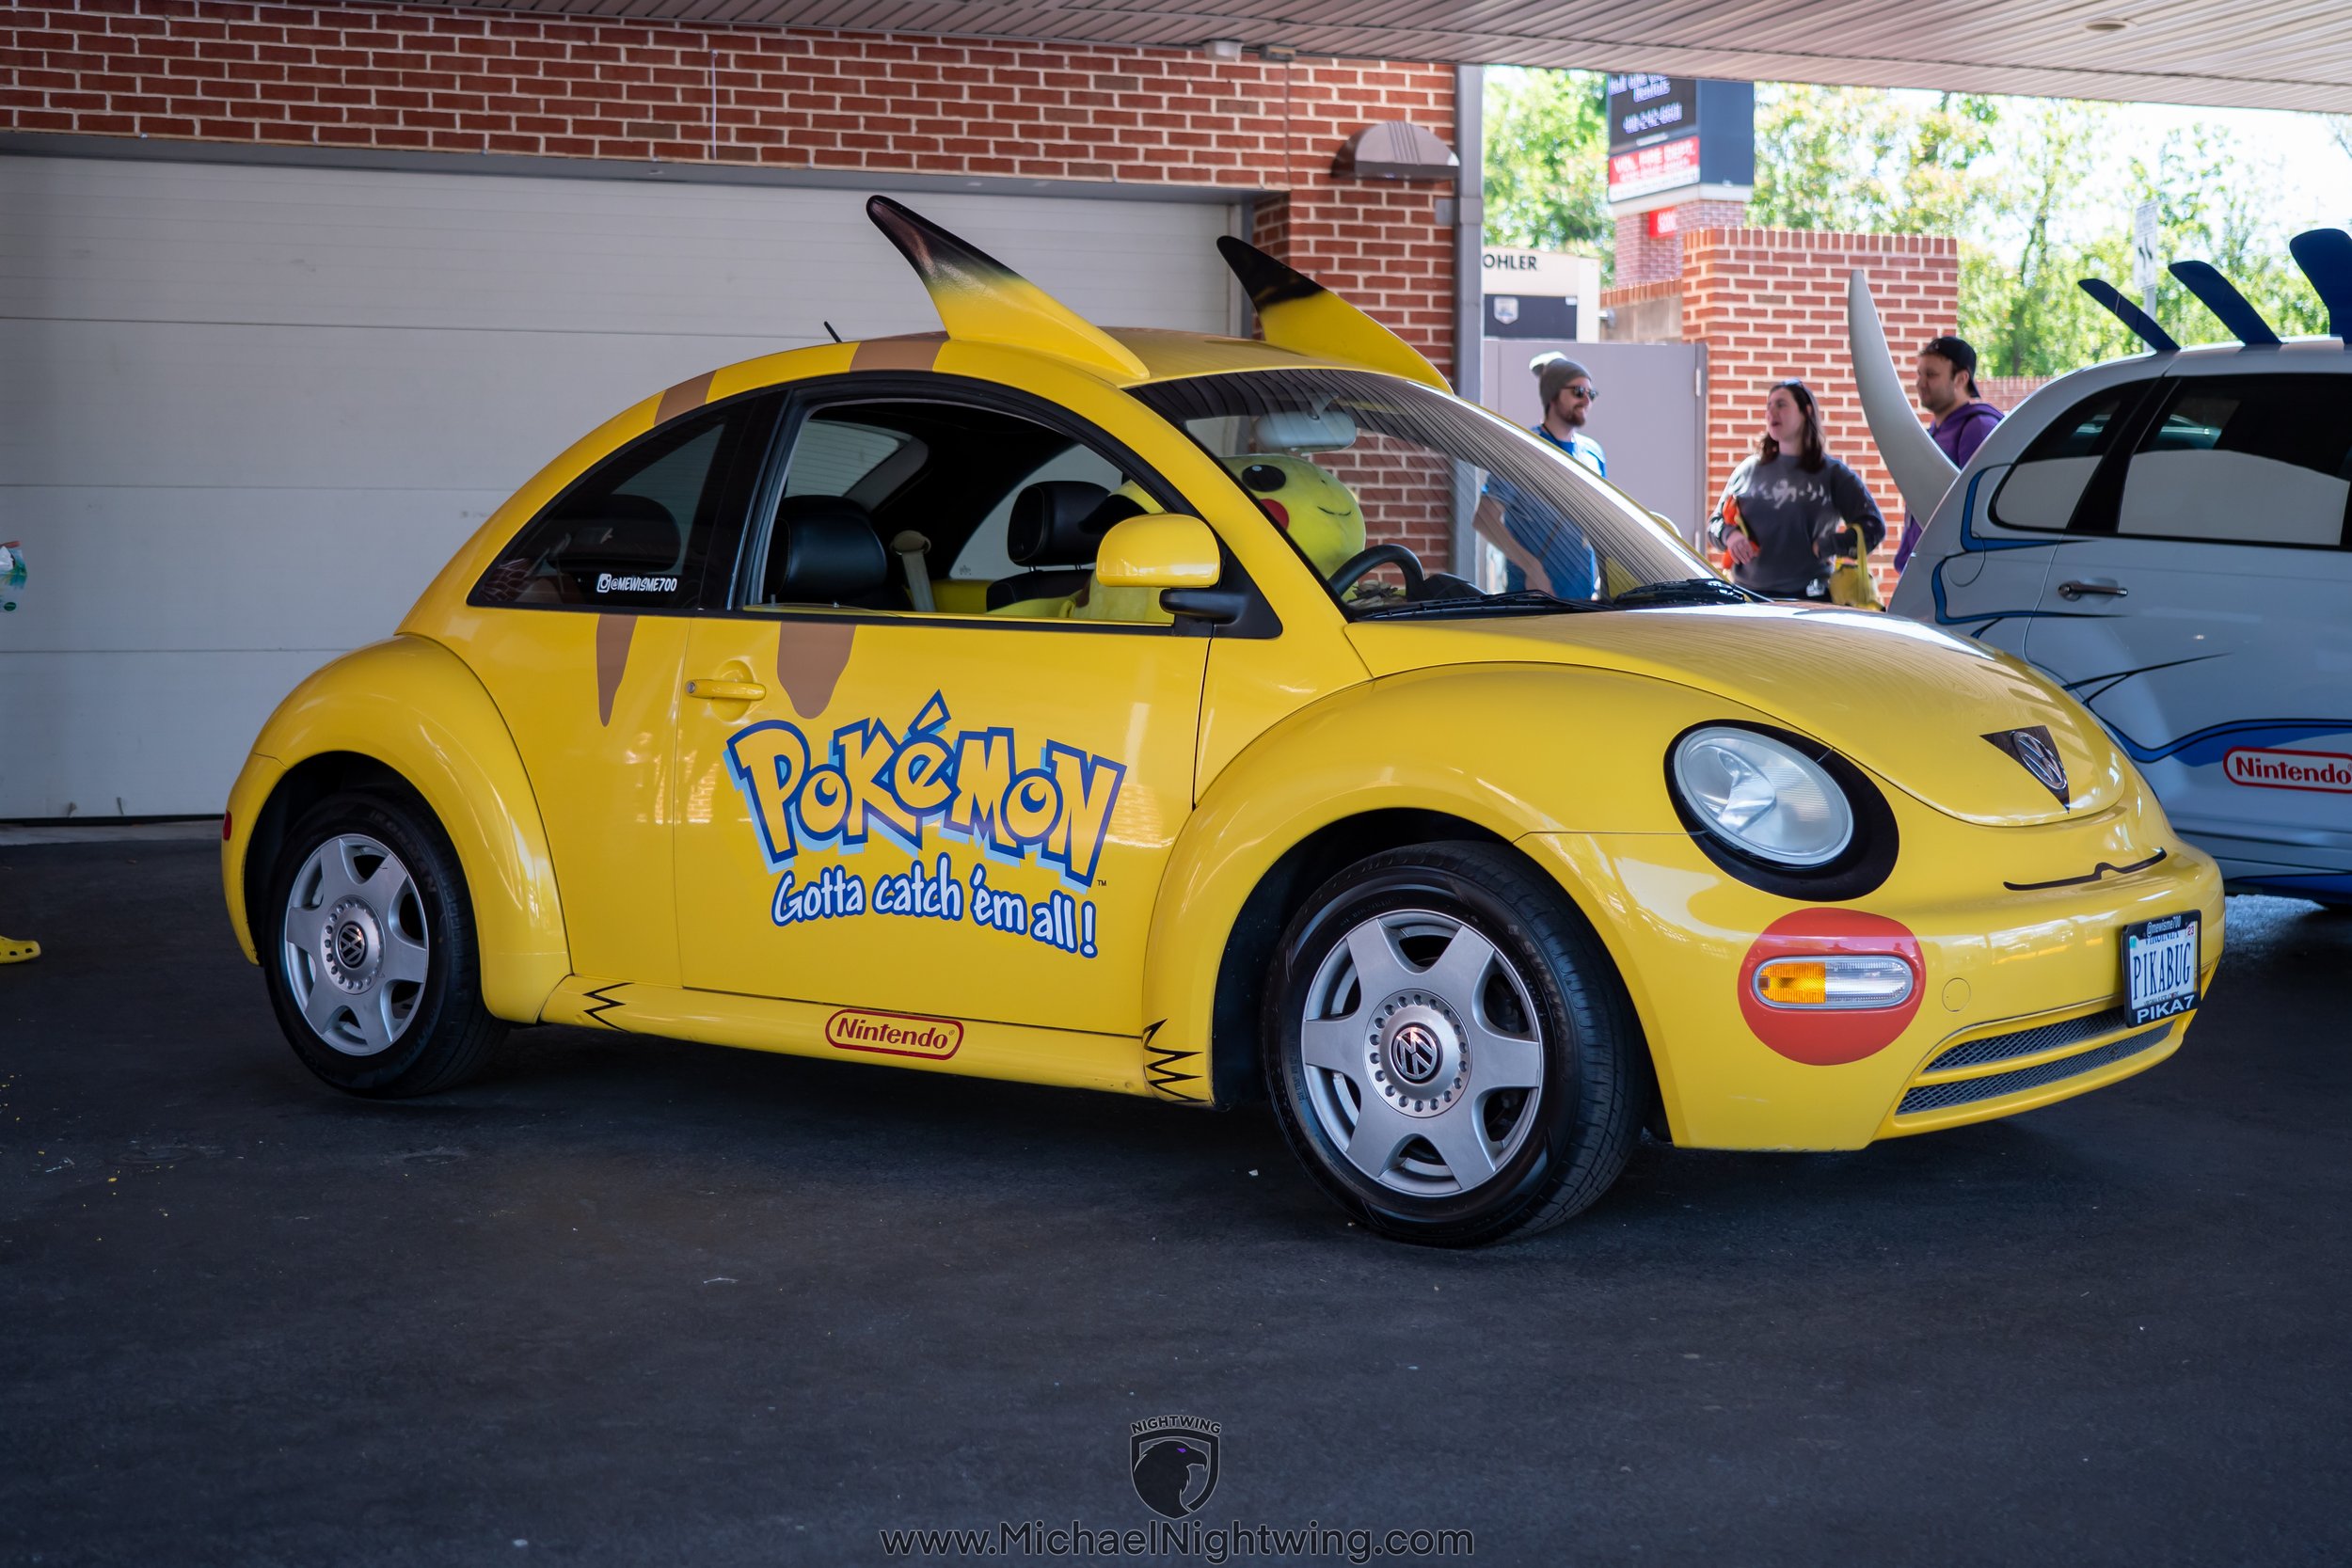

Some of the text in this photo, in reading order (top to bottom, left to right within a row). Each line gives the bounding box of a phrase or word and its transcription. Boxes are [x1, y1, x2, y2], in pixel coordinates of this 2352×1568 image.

[2235, 756, 2352, 785] Nintendo
[771, 869, 866, 927] Gotta
[872, 852, 962, 921] catch
[2134, 942, 2191, 1000] PIKABUG
[836, 1017, 948, 1049] Nintendo
